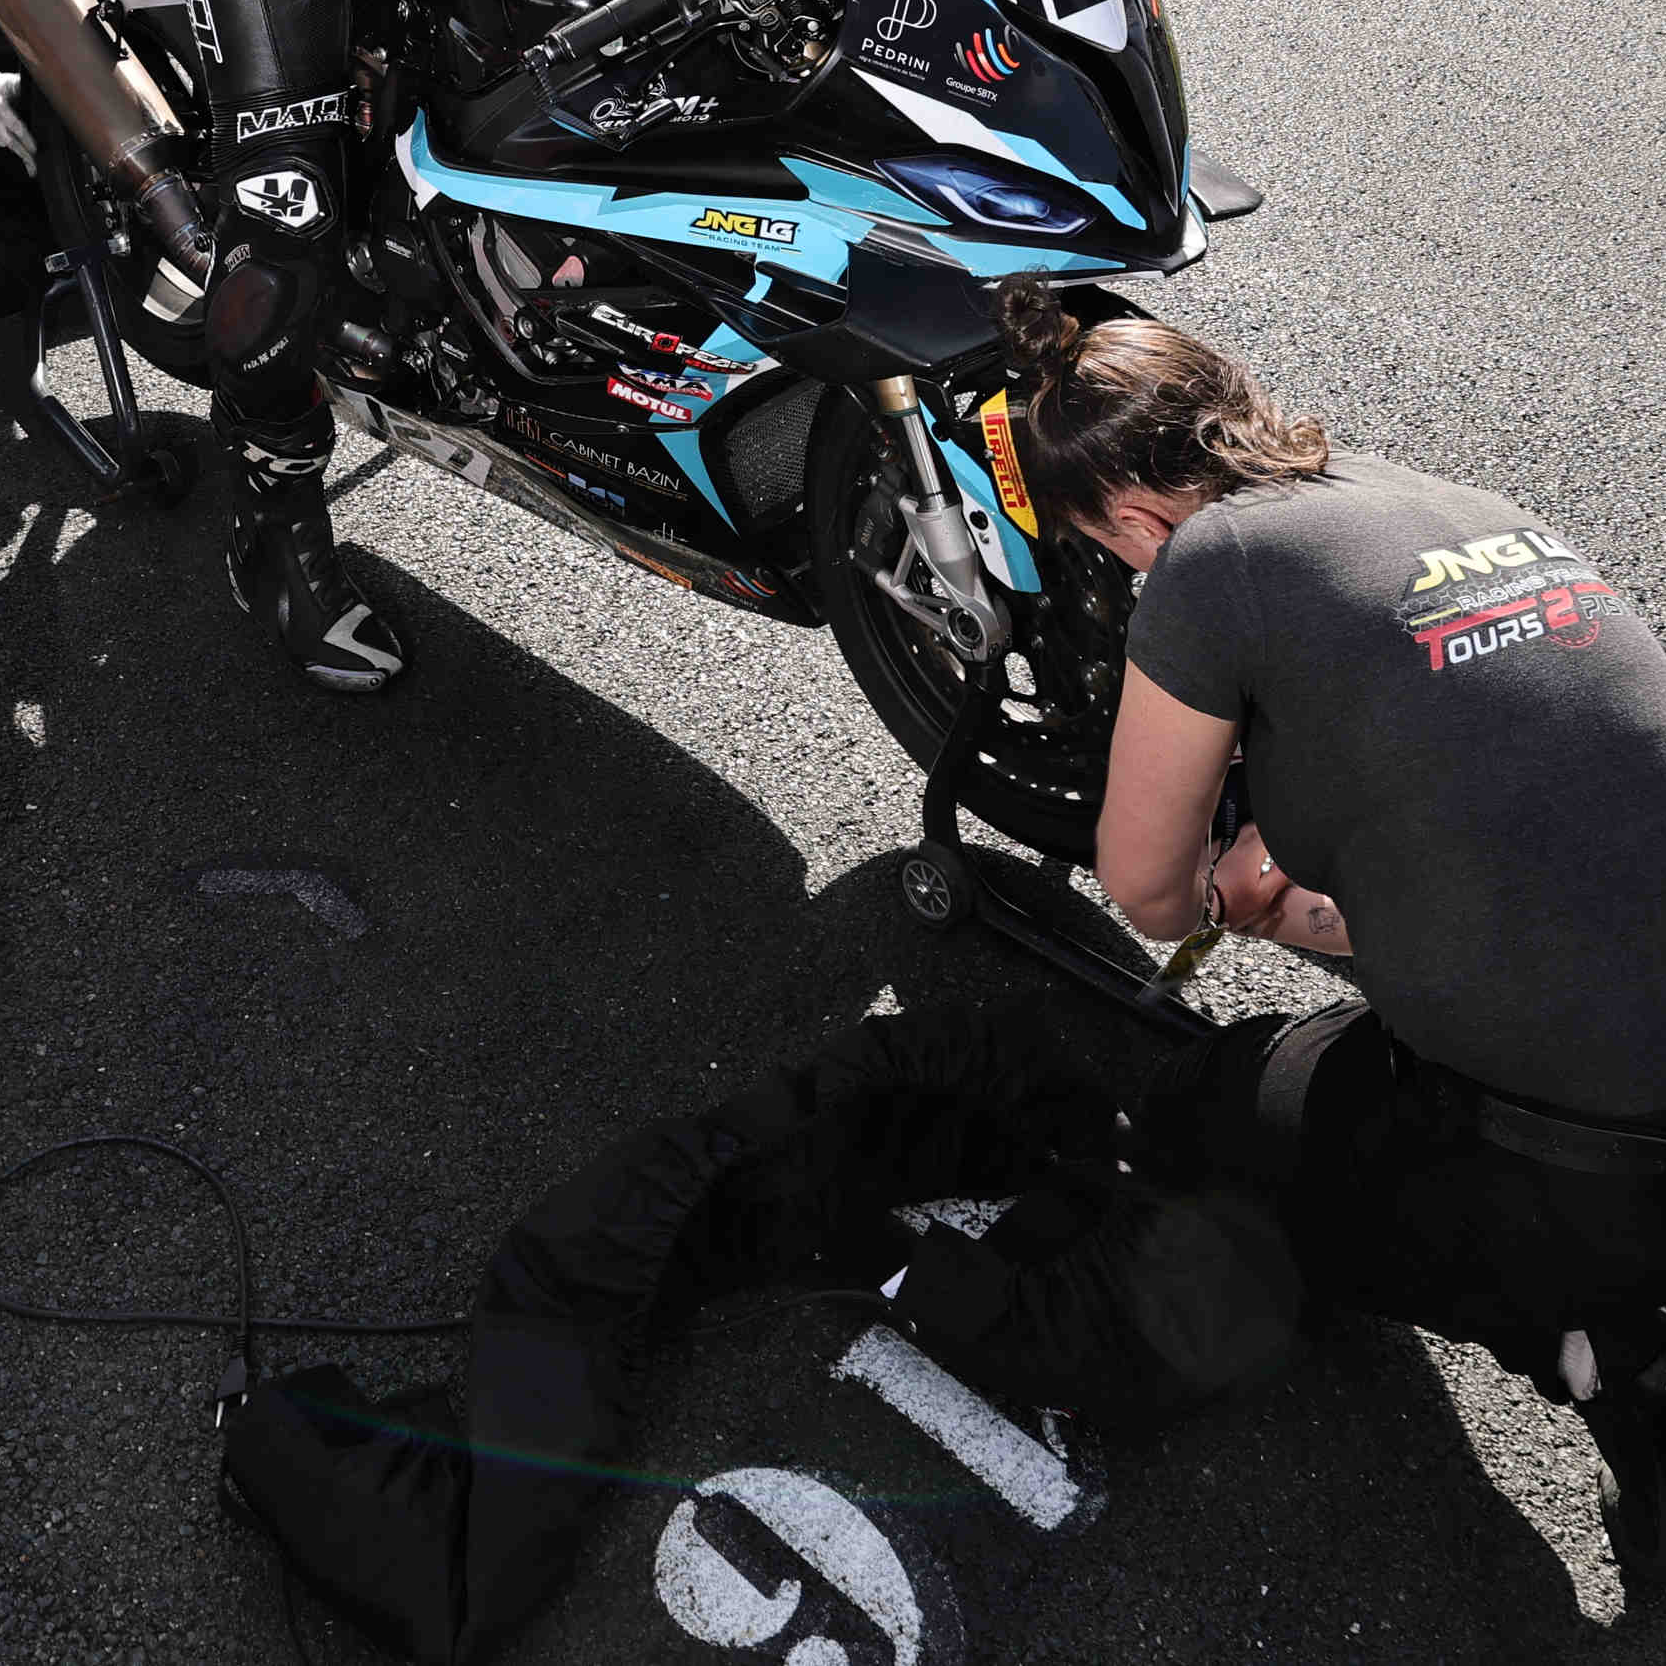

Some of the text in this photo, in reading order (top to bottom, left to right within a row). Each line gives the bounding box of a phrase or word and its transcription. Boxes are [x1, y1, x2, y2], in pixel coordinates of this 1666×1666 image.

[861, 38, 930, 73] PEDRINI
[946, 77, 977, 95] Groupe
[691, 208, 798, 244] JNG LG
[709, 234, 781, 252] RACING TEAM
[611, 382, 688, 420] MOTUL
[550, 432, 621, 470] CABINET
[627, 461, 680, 491] BAZIN
[984, 413, 1028, 508] PIRELLI
[1413, 533, 1538, 593] JNG
[1456, 575, 1547, 612] RACING
